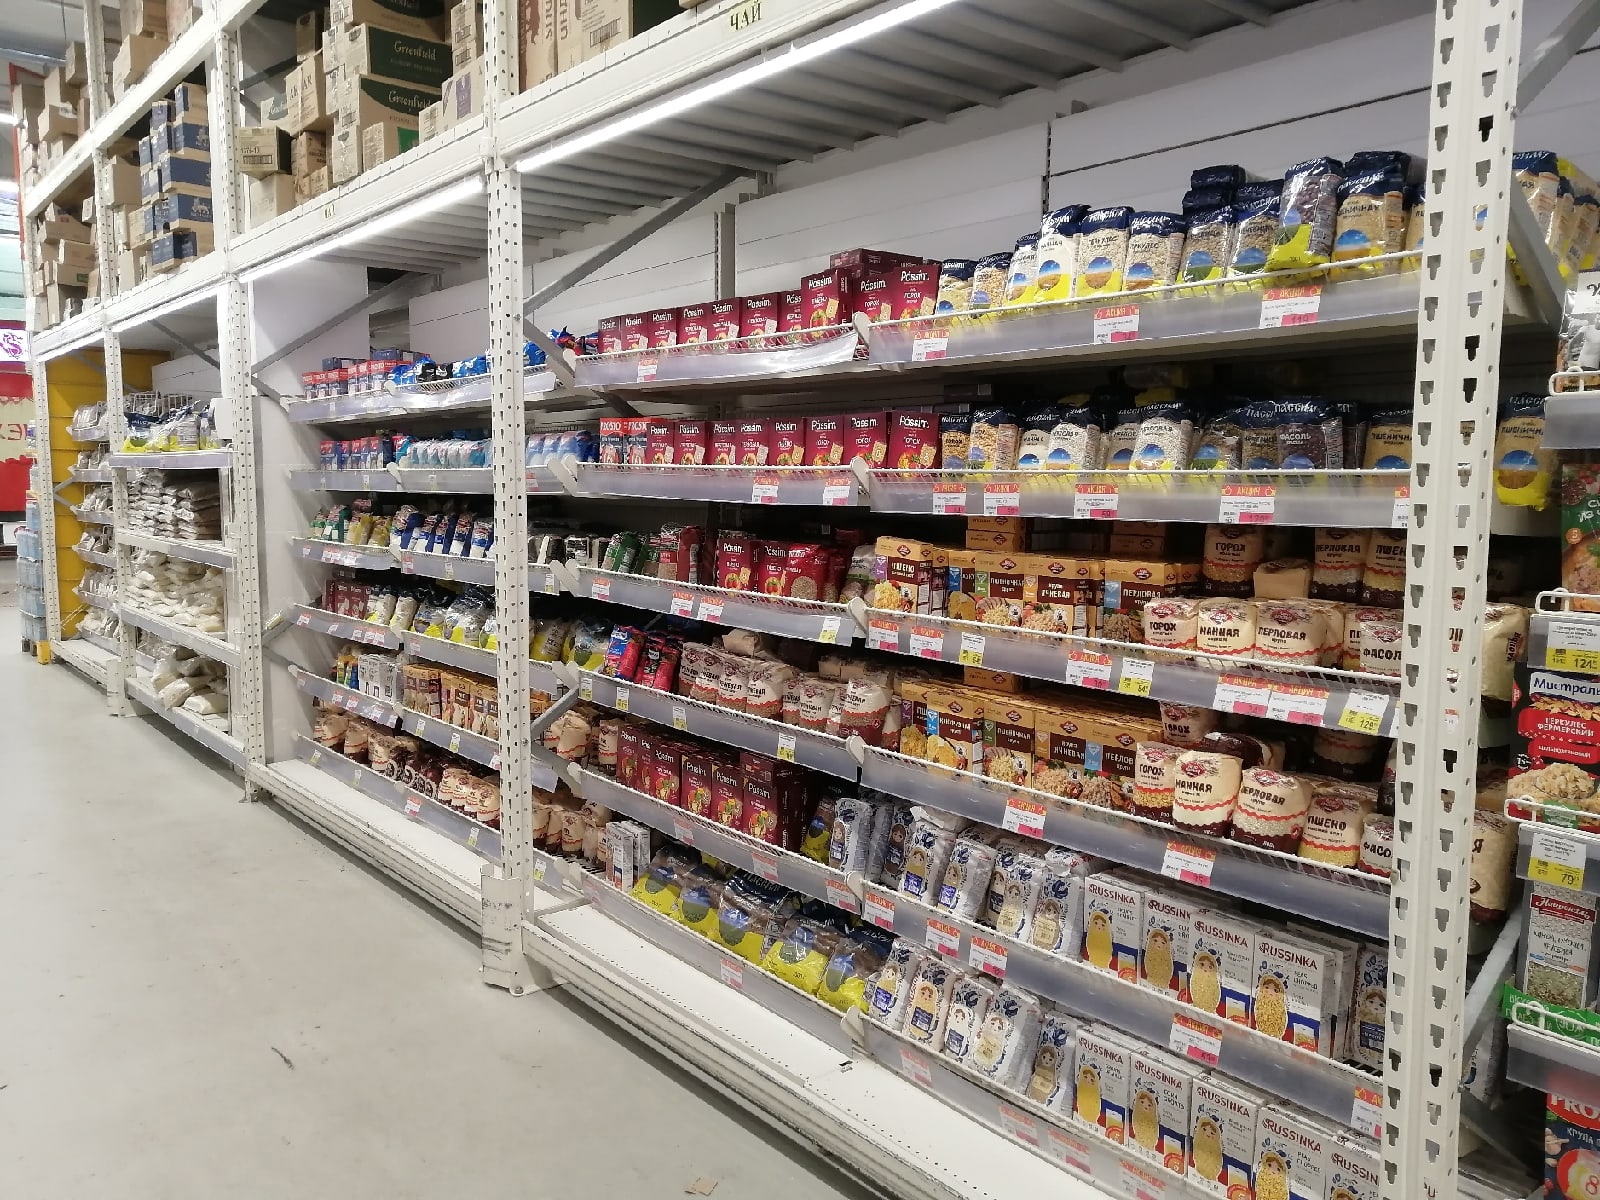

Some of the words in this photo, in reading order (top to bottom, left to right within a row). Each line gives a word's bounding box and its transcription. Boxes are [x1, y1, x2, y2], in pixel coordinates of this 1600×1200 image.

[730, 1, 762, 31] ЧАЙ
[394, 41, 437, 61] Greenfield
[388, 91, 433, 111] Greenfield
[1279, 432, 1311, 442] ФАСОЛЬ
[1371, 432, 1412, 441] ПШЕНИЧН
[1215, 542, 1246, 553] ГОРОХ
[1149, 621, 1177, 632] ГОРОХ
[1199, 626, 1240, 638] МАННАЯ
[1257, 626, 1307, 641] ПЕРЛОВАЯ
[1363, 648, 1402, 661] ФАСОЛ
[1164, 722, 1190, 734] ГОРОХ
[1538, 722, 1594, 737] ФЕРМЕРСКИЙ
[1545, 717, 1587, 730] ГЕРКУЛЕС
[1105, 752, 1134, 765] ПЕРЛОВ
[1139, 763, 1165, 777] ГОРОХ
[1175, 778, 1213, 794] МАННАЯ
[1307, 815, 1347, 831] ПШЕНО
[1363, 841, 1392, 858] ФАСО
[1089, 883, 1136, 905] RUSSINKA
[1195, 920, 1248, 948] RUSSINKA
[1260, 942, 1318, 970] RUSSINKA
[1078, 1037, 1124, 1065] RUSSINKA
[1135, 1060, 1183, 1091] RUSSINKA
[1196, 1086, 1250, 1118] RUSSINKA
[1262, 1118, 1322, 1154] RUSSINKA
[1566, 1127, 1594, 1145] КРУПА
